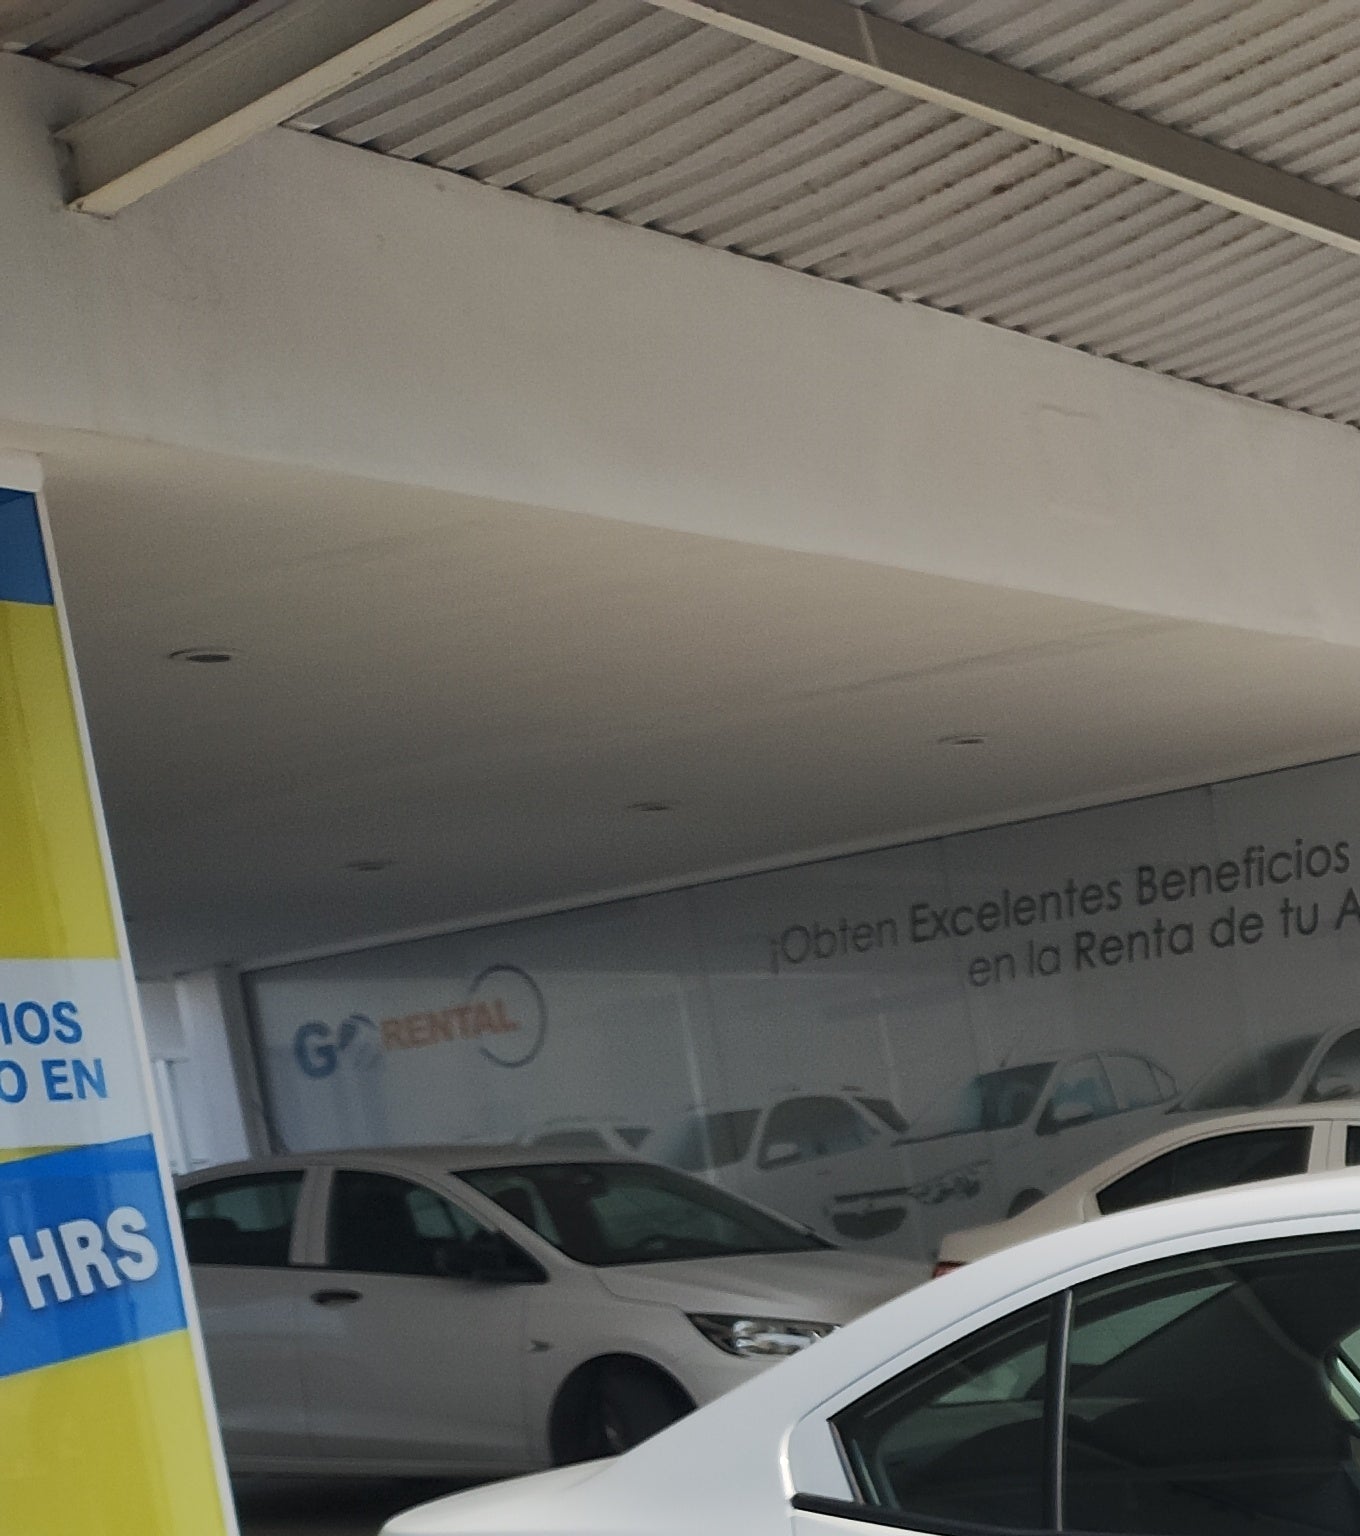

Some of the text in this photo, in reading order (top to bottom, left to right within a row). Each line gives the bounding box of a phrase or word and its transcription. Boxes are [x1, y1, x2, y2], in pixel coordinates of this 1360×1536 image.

[909, 878, 1122, 943] Excelentes
[1136, 838, 1350, 905] Beneficios
[968, 951, 1016, 987] en
[1027, 939, 1061, 978] la
[1075, 917, 1194, 970] Renta
[1209, 906, 1265, 948] de
[1279, 897, 1319, 938] tu
[41, 1058, 107, 1101] EN
[9, 1206, 158, 1310] HRS
